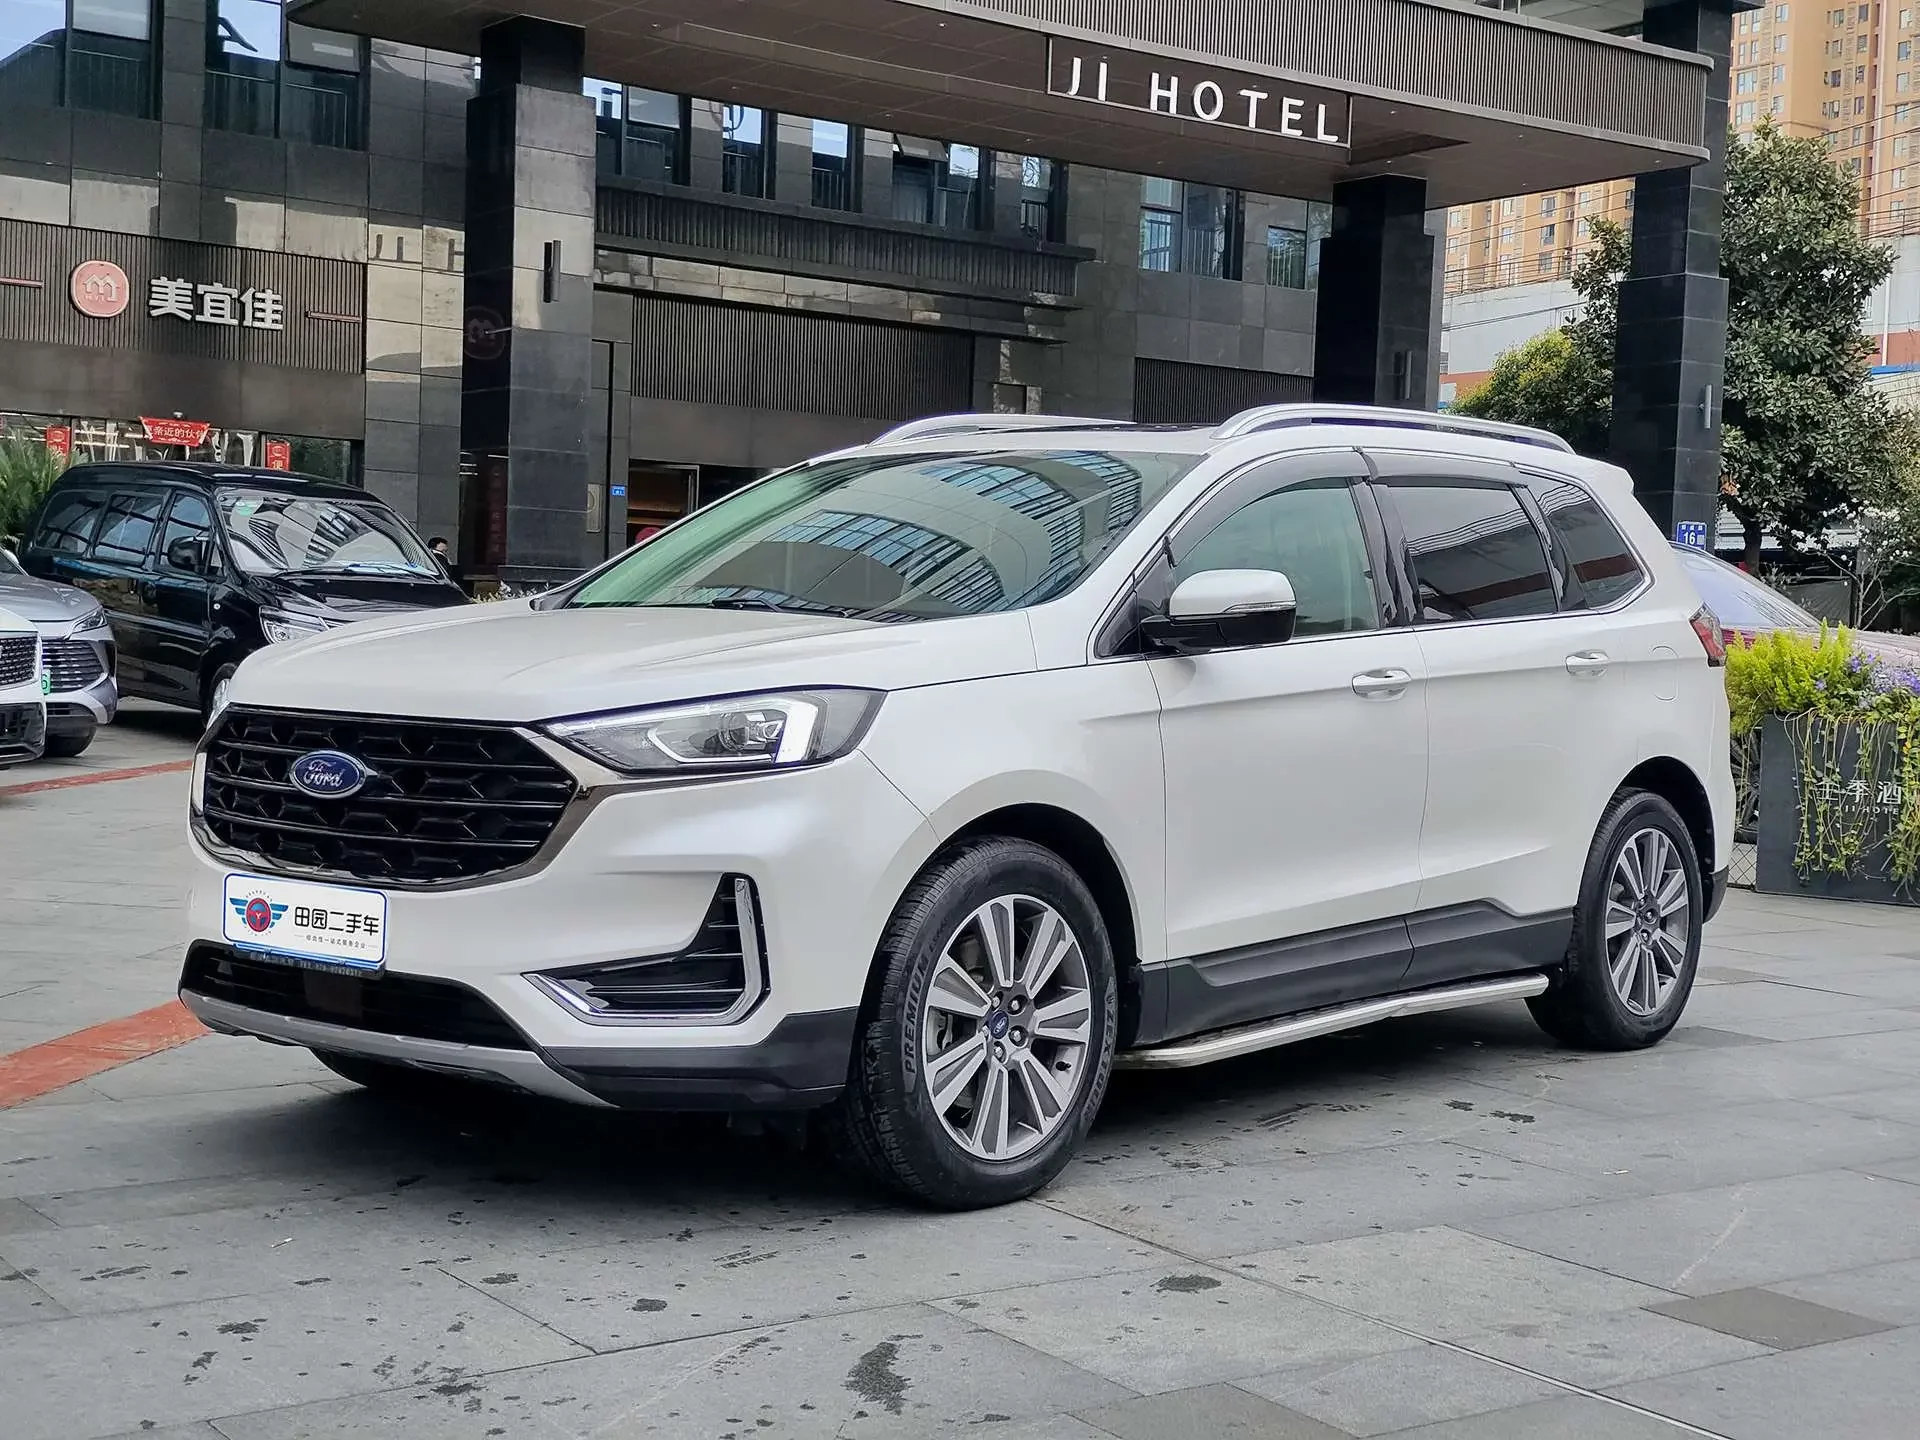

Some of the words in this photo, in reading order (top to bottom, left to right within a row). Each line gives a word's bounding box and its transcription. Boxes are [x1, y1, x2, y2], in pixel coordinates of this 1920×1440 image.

[1067, 56, 1108, 101] JI
[1150, 72, 1339, 143] HOTEL
[149, 276, 283, 330] 美宜佳
[303, 759, 346, 788] Ford
[1812, 778, 1902, 805] 全季酒
[1863, 804, 1900, 816] HOTE
[294, 906, 380, 936] 田园二手车
[904, 954, 931, 1074] PREMIUM
